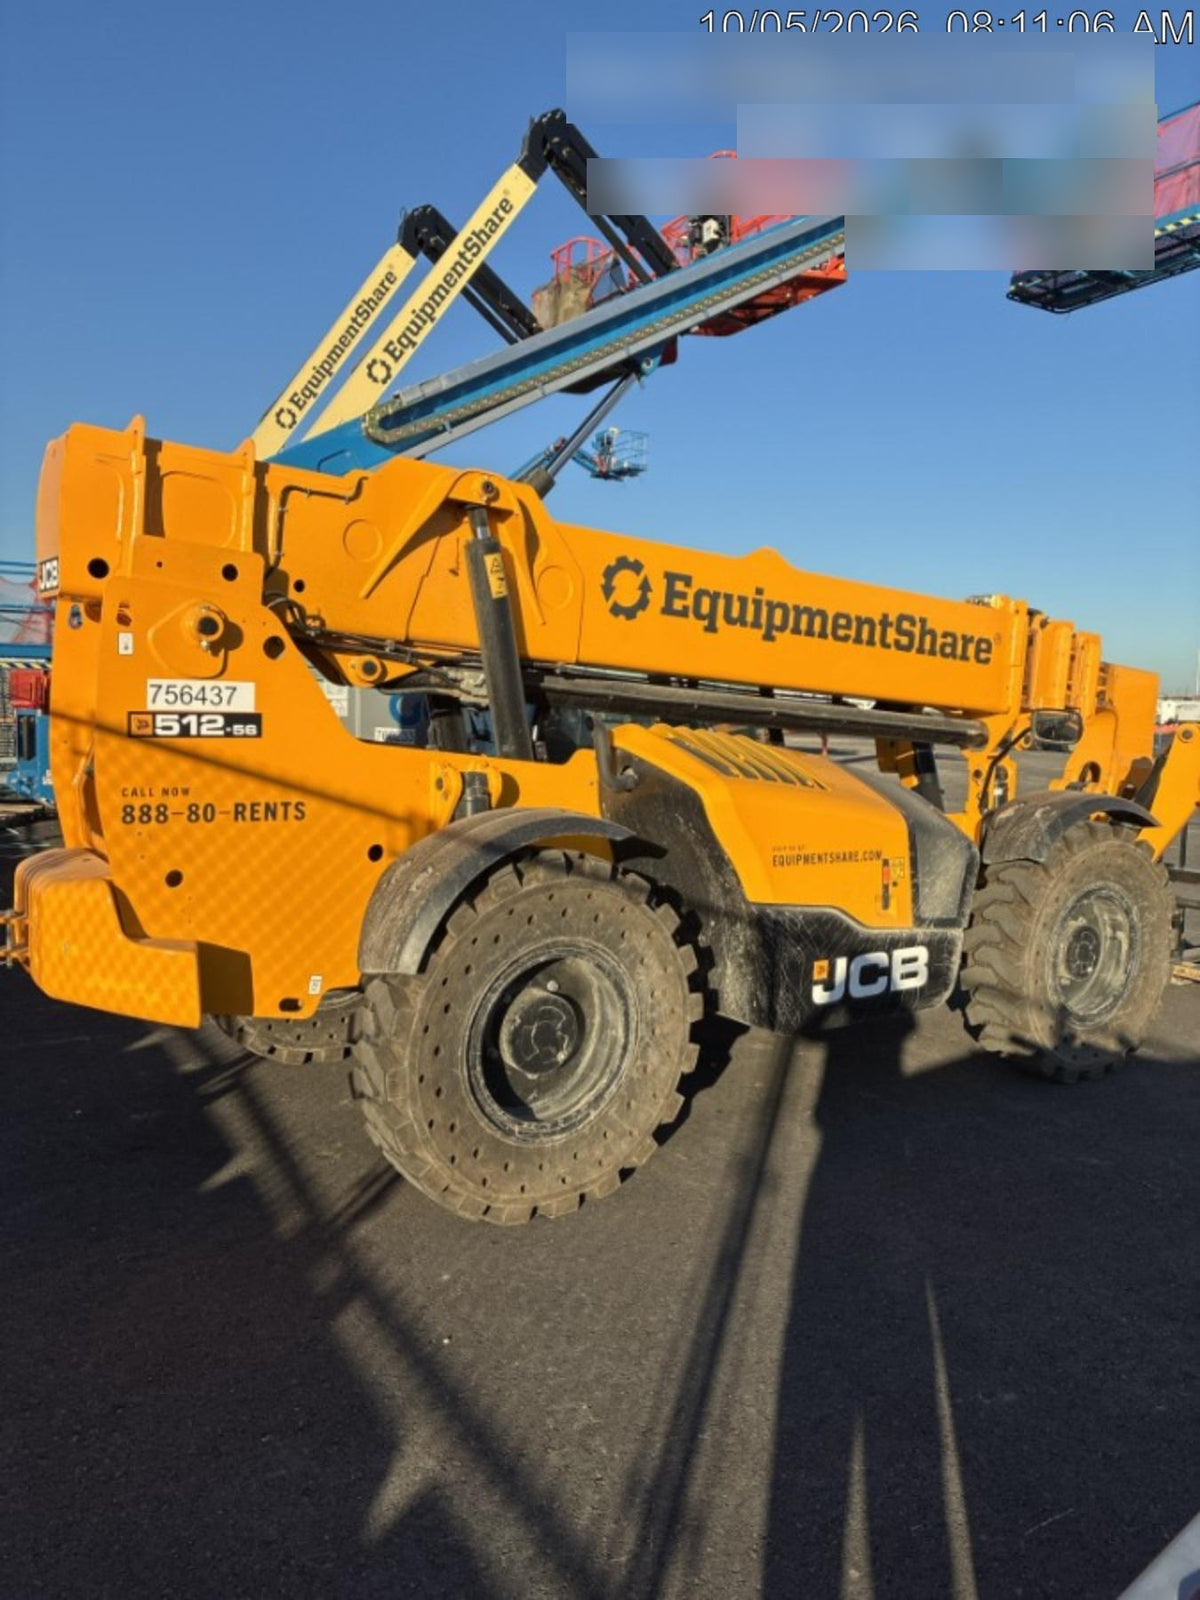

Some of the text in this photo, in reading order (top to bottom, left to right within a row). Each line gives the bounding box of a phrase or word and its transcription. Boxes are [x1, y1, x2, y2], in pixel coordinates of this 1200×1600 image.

[383, 197, 513, 363] EquipmentShare
[290, 269, 398, 411] EquipmentShare
[660, 570, 993, 665] EquipmentShare
[149, 683, 238, 706] 756437
[121, 786, 191, 798] CALL NOW
[121, 801, 306, 825] 888-80-RENTS
[772, 850, 882, 867] EQUIPMENTSHARE.COM
[812, 945, 929, 1005] JCB
